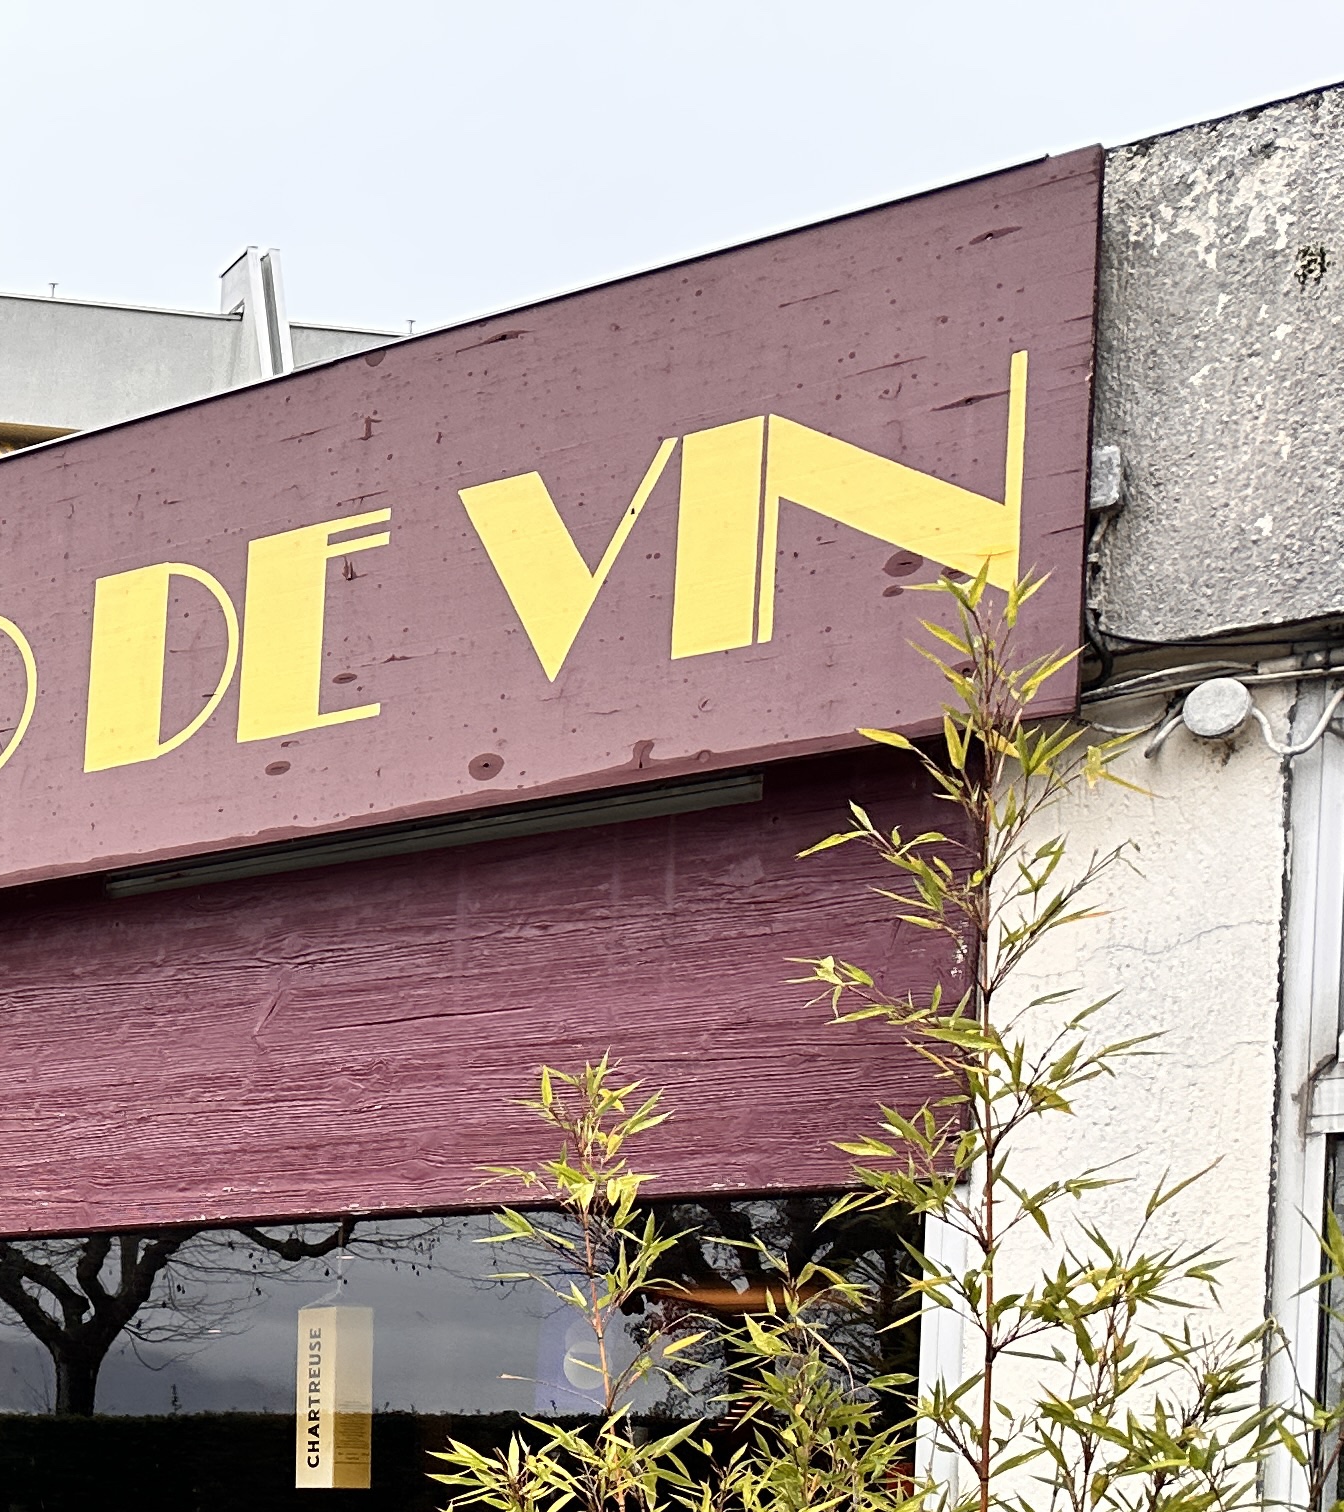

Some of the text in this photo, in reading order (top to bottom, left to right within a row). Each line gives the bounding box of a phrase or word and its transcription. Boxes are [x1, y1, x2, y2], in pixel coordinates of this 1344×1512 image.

[82, 506, 392, 773] DE
[457, 349, 1028, 683] VIN
[307, 1326, 322, 1469] CHARTREUSE
